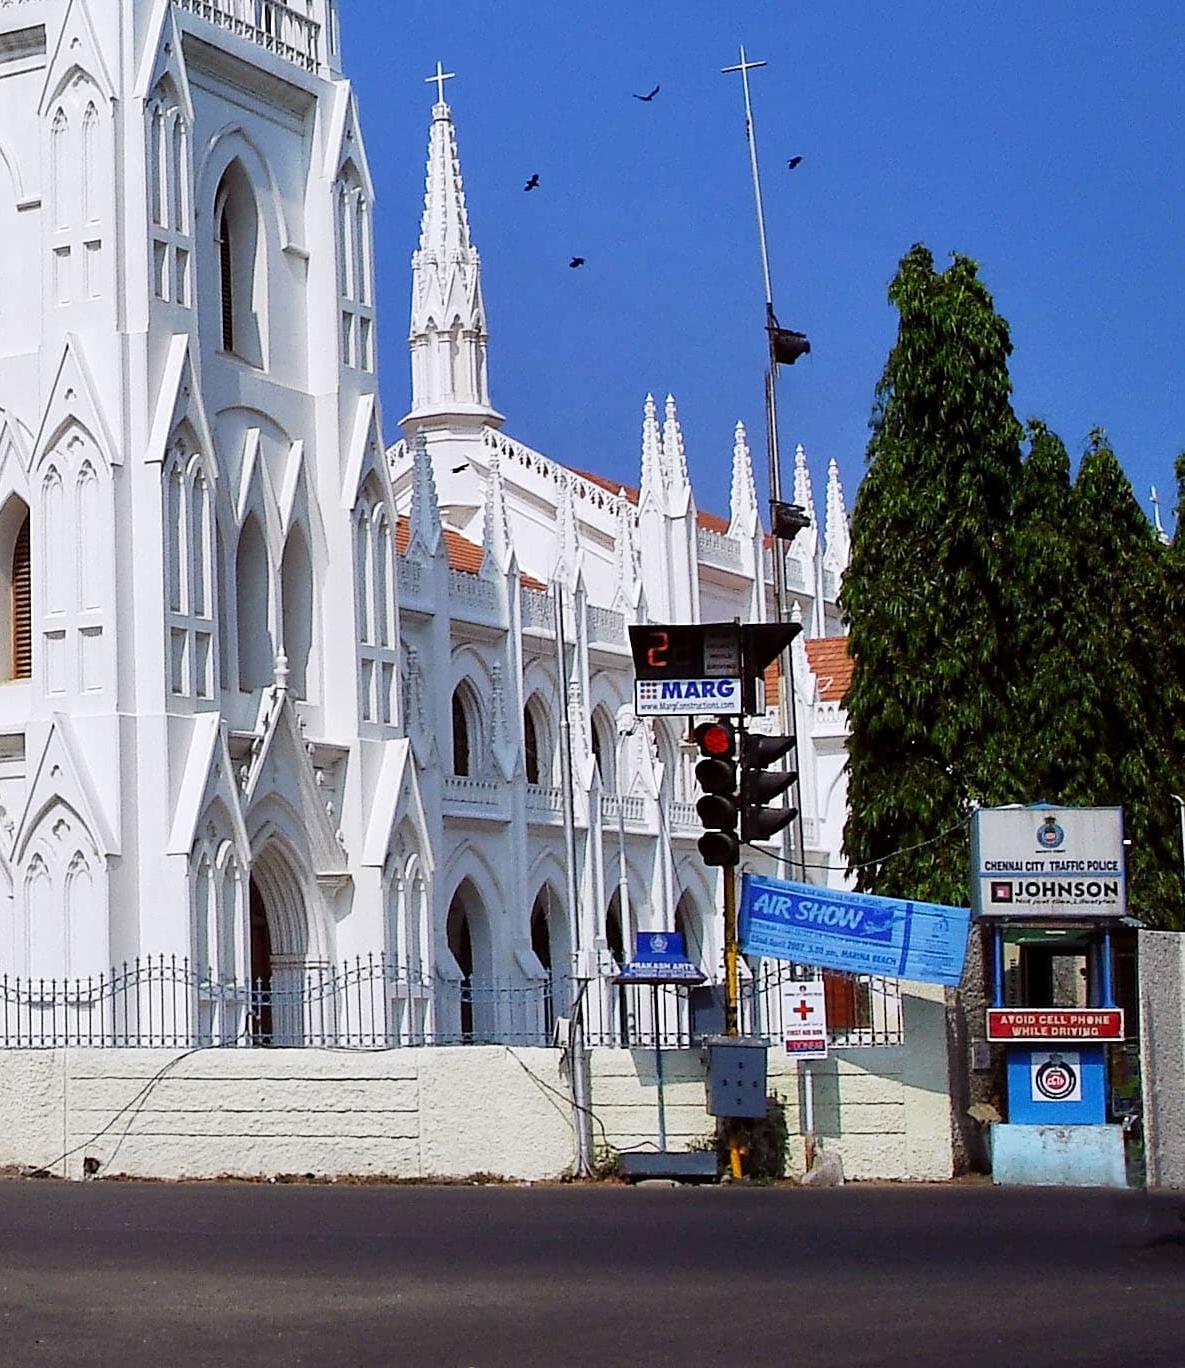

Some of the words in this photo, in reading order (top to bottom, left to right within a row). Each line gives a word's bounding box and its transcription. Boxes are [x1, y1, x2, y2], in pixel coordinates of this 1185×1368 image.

[648, 632, 669, 666] 2
[661, 680, 735, 699] MARG
[984, 861, 1023, 871] CHENNAI
[1025, 861, 1045, 872] CITY
[1050, 861, 1085, 871] TRAFFIC
[1087, 861, 1118, 871] POLICE
[1015, 882, 1118, 897] JOHNSON
[753, 893, 791, 919] AIR
[795, 901, 864, 930] SHOW
[1000, 1016, 1035, 1024] AVOID
[1038, 1016, 1067, 1024] CELL
[1070, 1016, 1110, 1024] PHONE
[1012, 1027, 1048, 1036] WHILE
[1051, 1027, 1099, 1036] DRIVING
